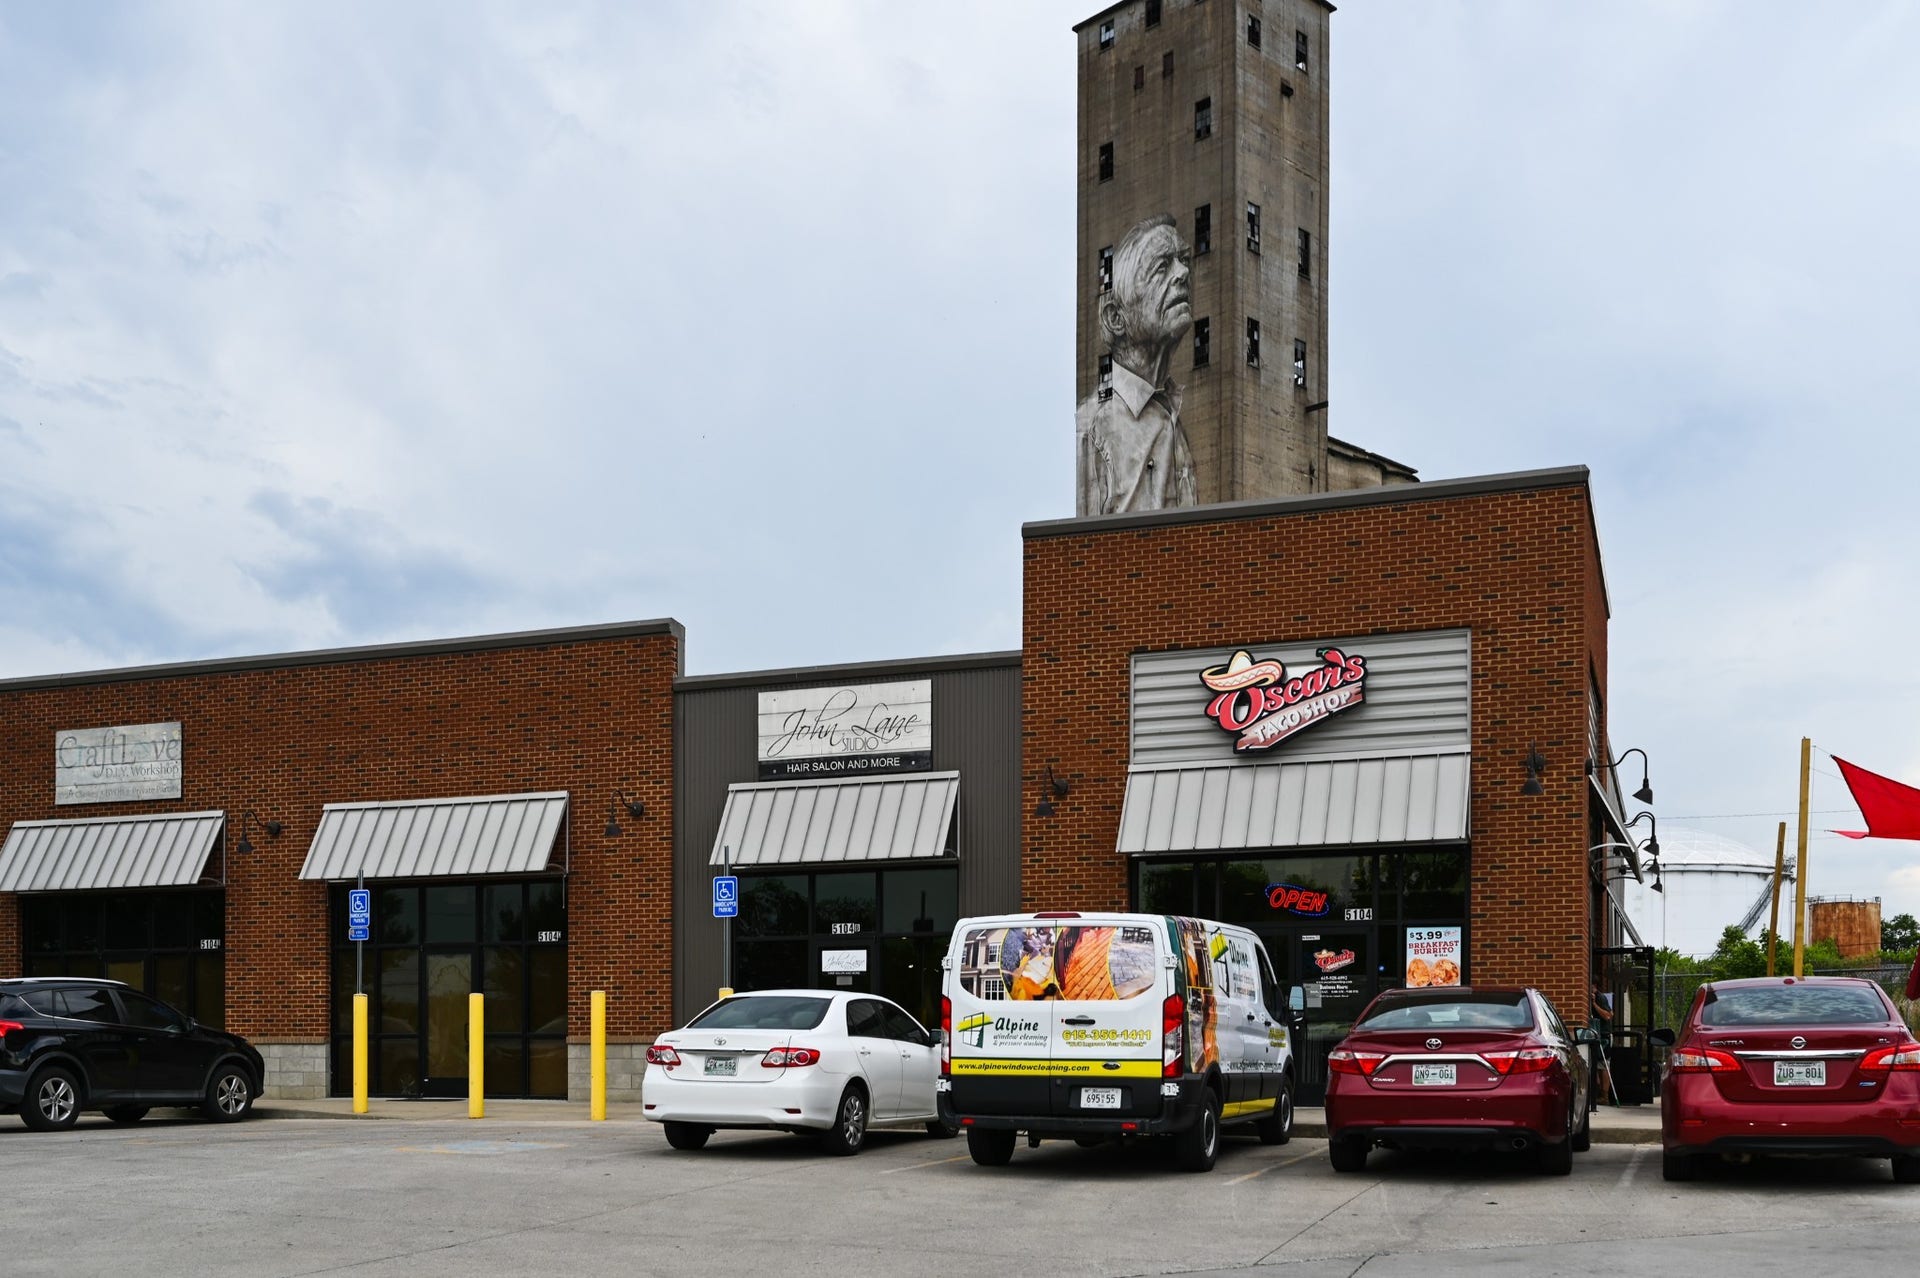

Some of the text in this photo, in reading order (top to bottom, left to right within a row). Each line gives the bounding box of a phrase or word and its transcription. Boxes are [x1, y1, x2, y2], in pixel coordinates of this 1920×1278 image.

[1206, 652, 1366, 731] Oscar's
[1254, 690, 1351, 743] TACO SHOP
[767, 690, 921, 757] John Lane
[842, 737, 879, 752] STUDIO
[131, 763, 178, 777] Workshop
[786, 757, 900, 774] HAIR SALON AND MORE
[1270, 887, 1327, 912] OPEN
[1345, 909, 1372, 920] 5104
[1410, 931, 1443, 940] $3.99
[1408, 940, 1460, 949] BREAKFAST
[1413, 946, 1454, 955] BURRITO
[995, 1017, 1039, 1033] Alpine
[1019, 1033, 1048, 1041] cleaning
[1062, 1029, 1152, 1040] 615-356-1411
[1023, 1040, 1047, 1048] washing
[958, 1062, 1090, 1072] www.alpinewindowcleaning.com
